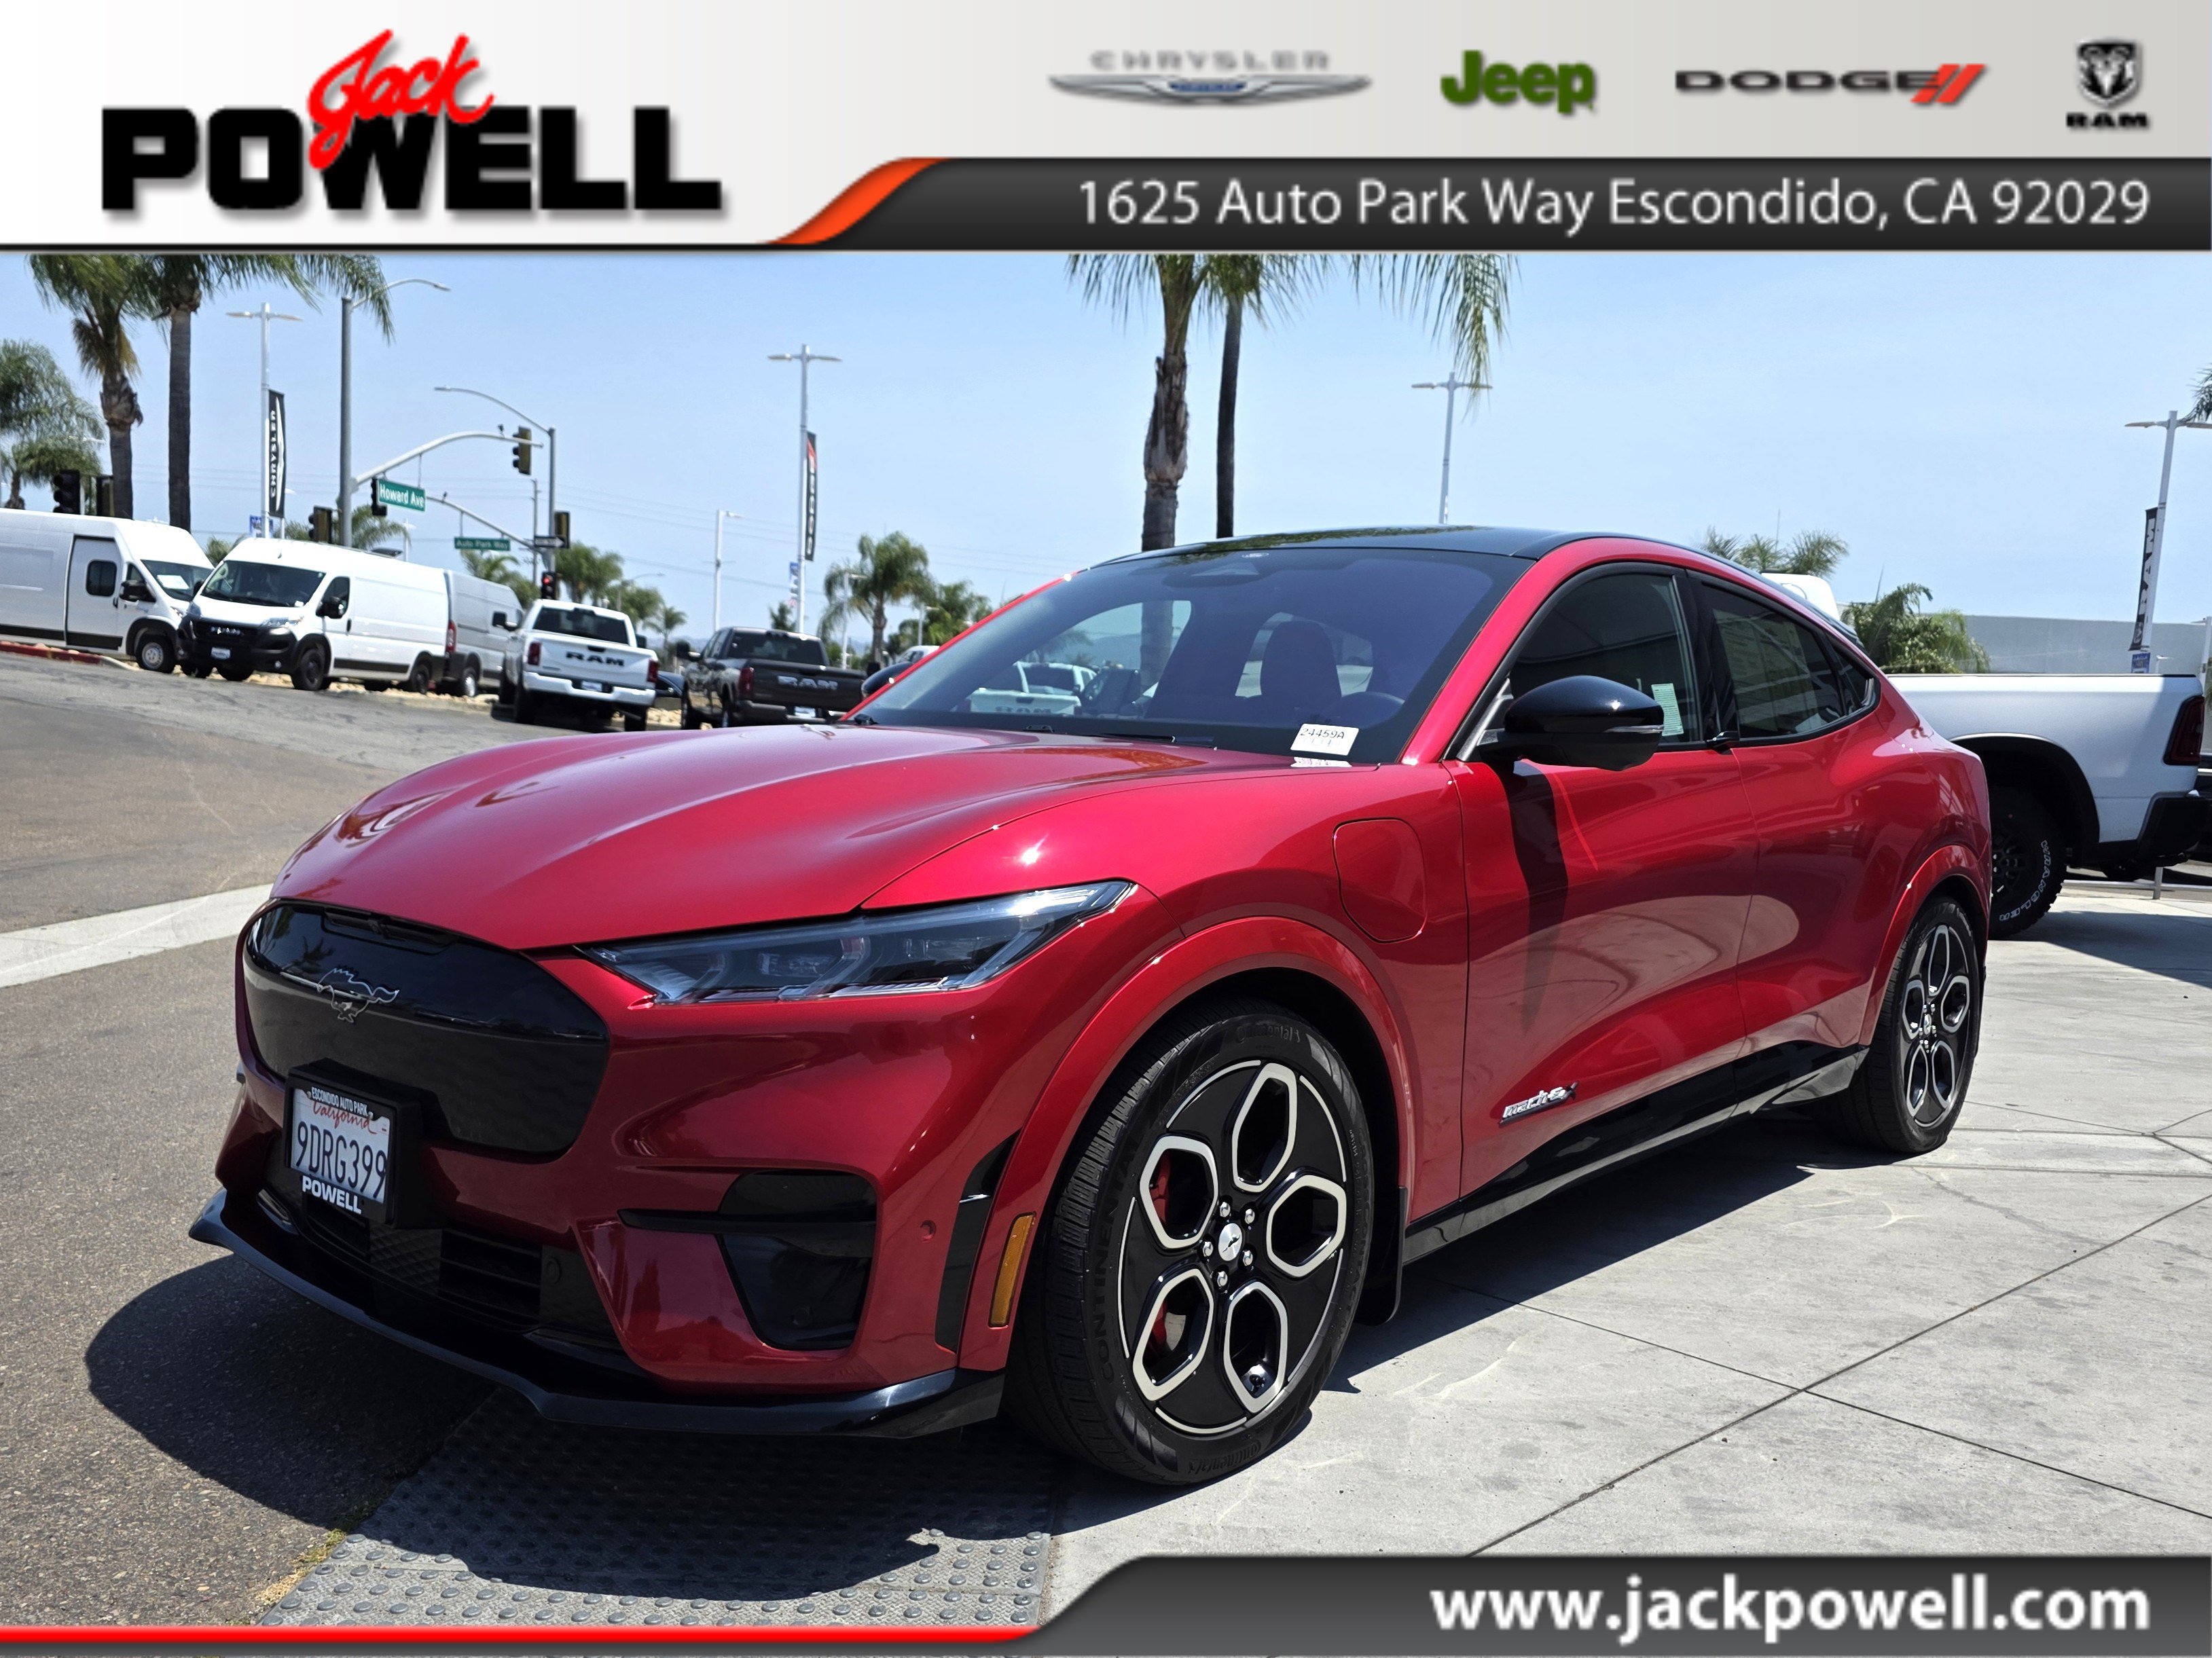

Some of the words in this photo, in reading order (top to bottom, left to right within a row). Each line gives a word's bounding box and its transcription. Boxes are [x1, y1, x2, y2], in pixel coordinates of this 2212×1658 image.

[380, 484, 408, 504] Howard
[410, 491, 424, 507] Ave
[456, 539, 473, 547] Auto
[566, 651, 625, 667] RAM
[778, 675, 838, 690] RAM
[1300, 728, 1345, 739] 24459A
[311, 1086, 340, 1107] ESCONDIDO
[340, 1096, 353, 1111] AUTO
[353, 1101, 368, 1116] PARK
[313, 1101, 377, 1135] California
[295, 1121, 387, 1198] 9DRG399
[302, 1175, 362, 1214] POWELL
